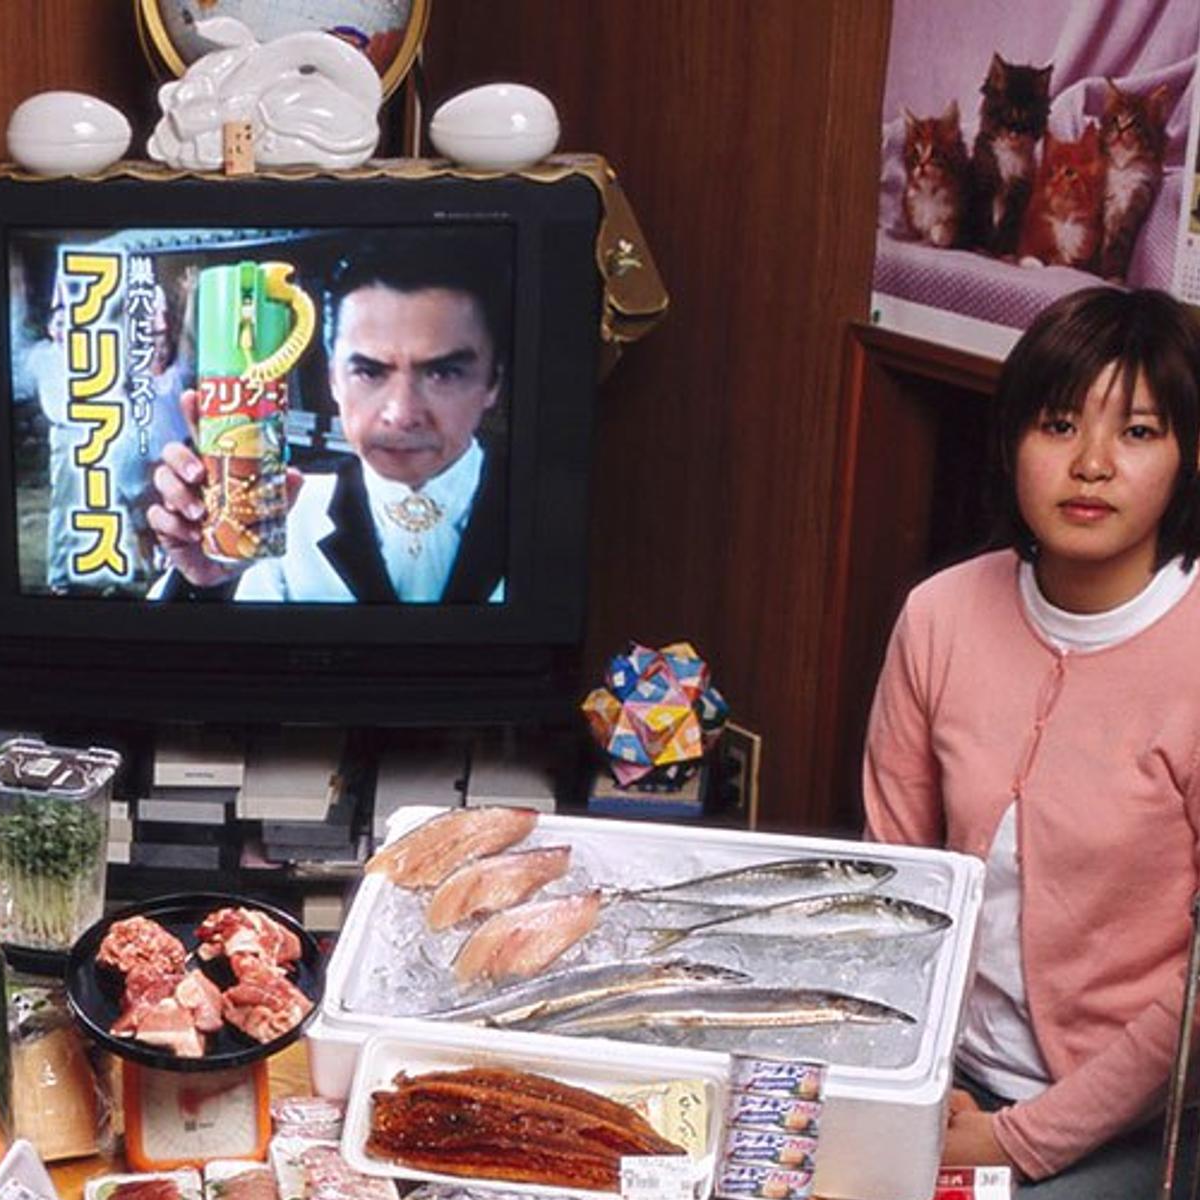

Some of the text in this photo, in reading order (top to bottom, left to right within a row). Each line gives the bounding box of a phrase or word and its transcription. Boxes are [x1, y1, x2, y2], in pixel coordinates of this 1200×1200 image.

[63, 249, 127, 577] アリアース
